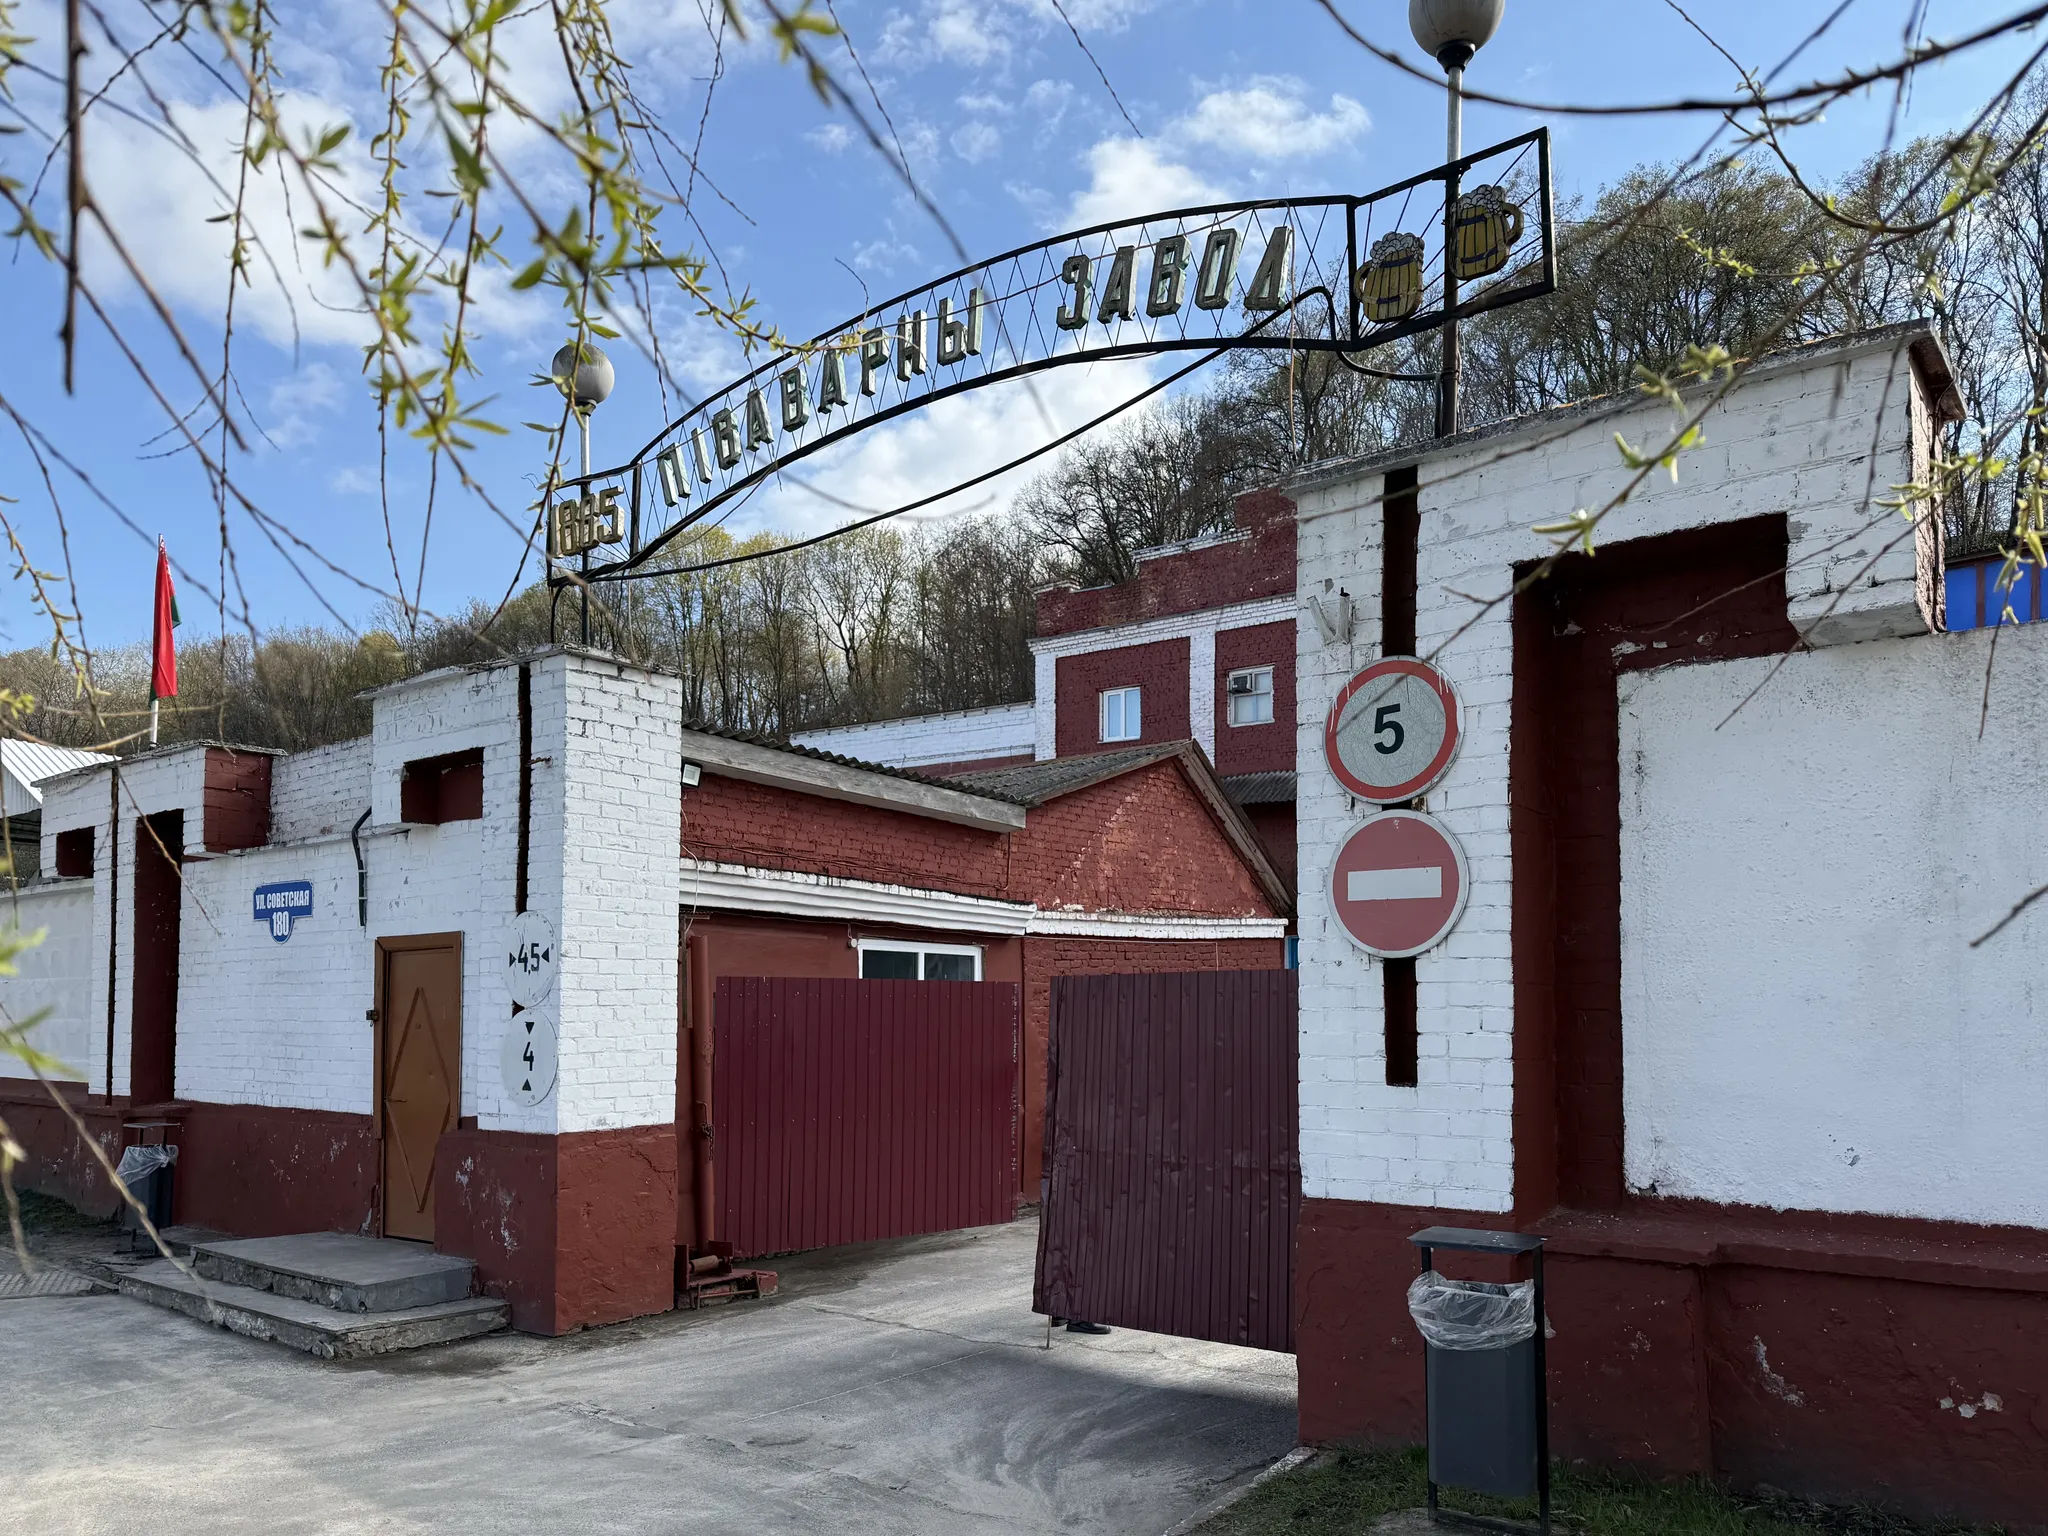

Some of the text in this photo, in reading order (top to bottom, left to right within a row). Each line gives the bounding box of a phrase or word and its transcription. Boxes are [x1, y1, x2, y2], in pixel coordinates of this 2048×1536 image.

[656, 287, 984, 507] ПІВАВАРНЫ
[1056, 226, 1295, 331] ЗАВОД
[1373, 703, 1405, 755] 5
[255, 890, 309, 910] УЛ. СОВЕТСКАЯ
[272, 911, 289, 936] 180
[517, 943, 540, 974] 4,5
[523, 1042, 534, 1071] 4
